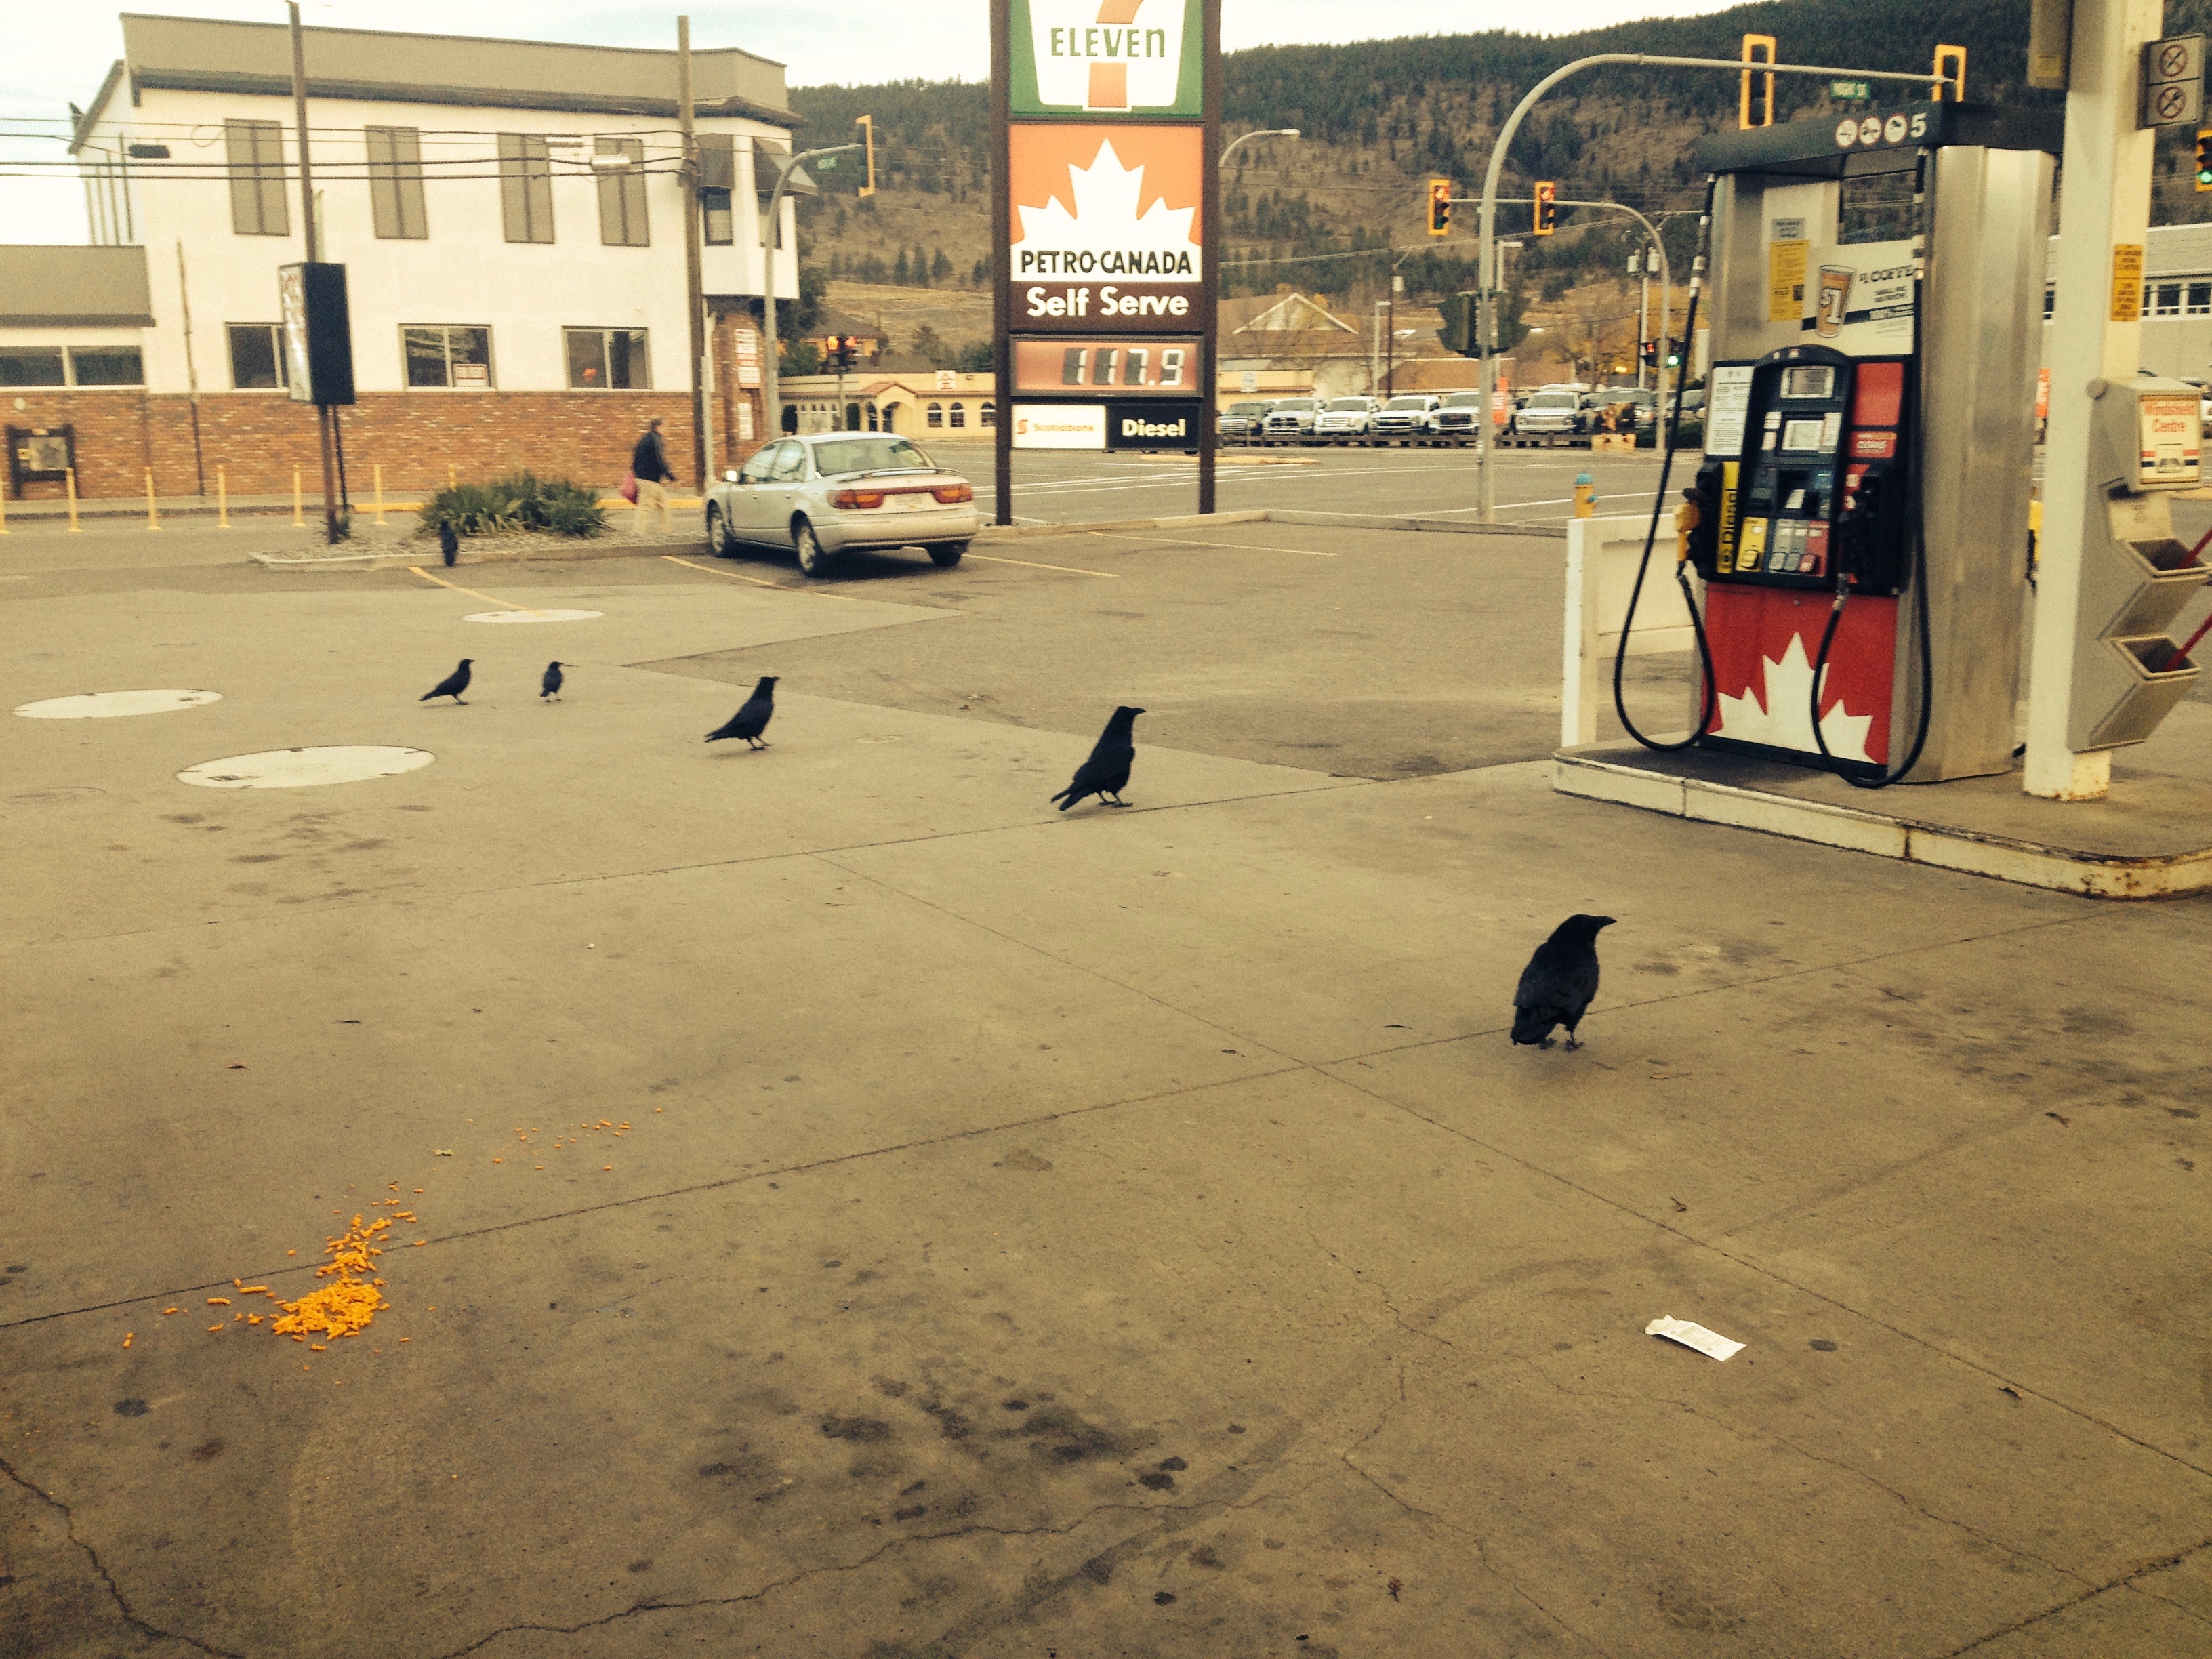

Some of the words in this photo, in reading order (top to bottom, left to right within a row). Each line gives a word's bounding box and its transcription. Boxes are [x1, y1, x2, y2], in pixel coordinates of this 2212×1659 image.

[1050, 27, 1166, 58] ELEVEN
[1910, 112, 1928, 138] 5
[1021, 250, 1193, 274] PETRO-CANADA
[1026, 287, 1090, 316] Self
[1099, 286, 1190, 316] Serve
[1075, 347, 1186, 386] 117.9
[1033, 422, 1094, 432] Scotiabank
[1122, 419, 1187, 436] Diesel
[1722, 488, 1738, 544] Diesel
